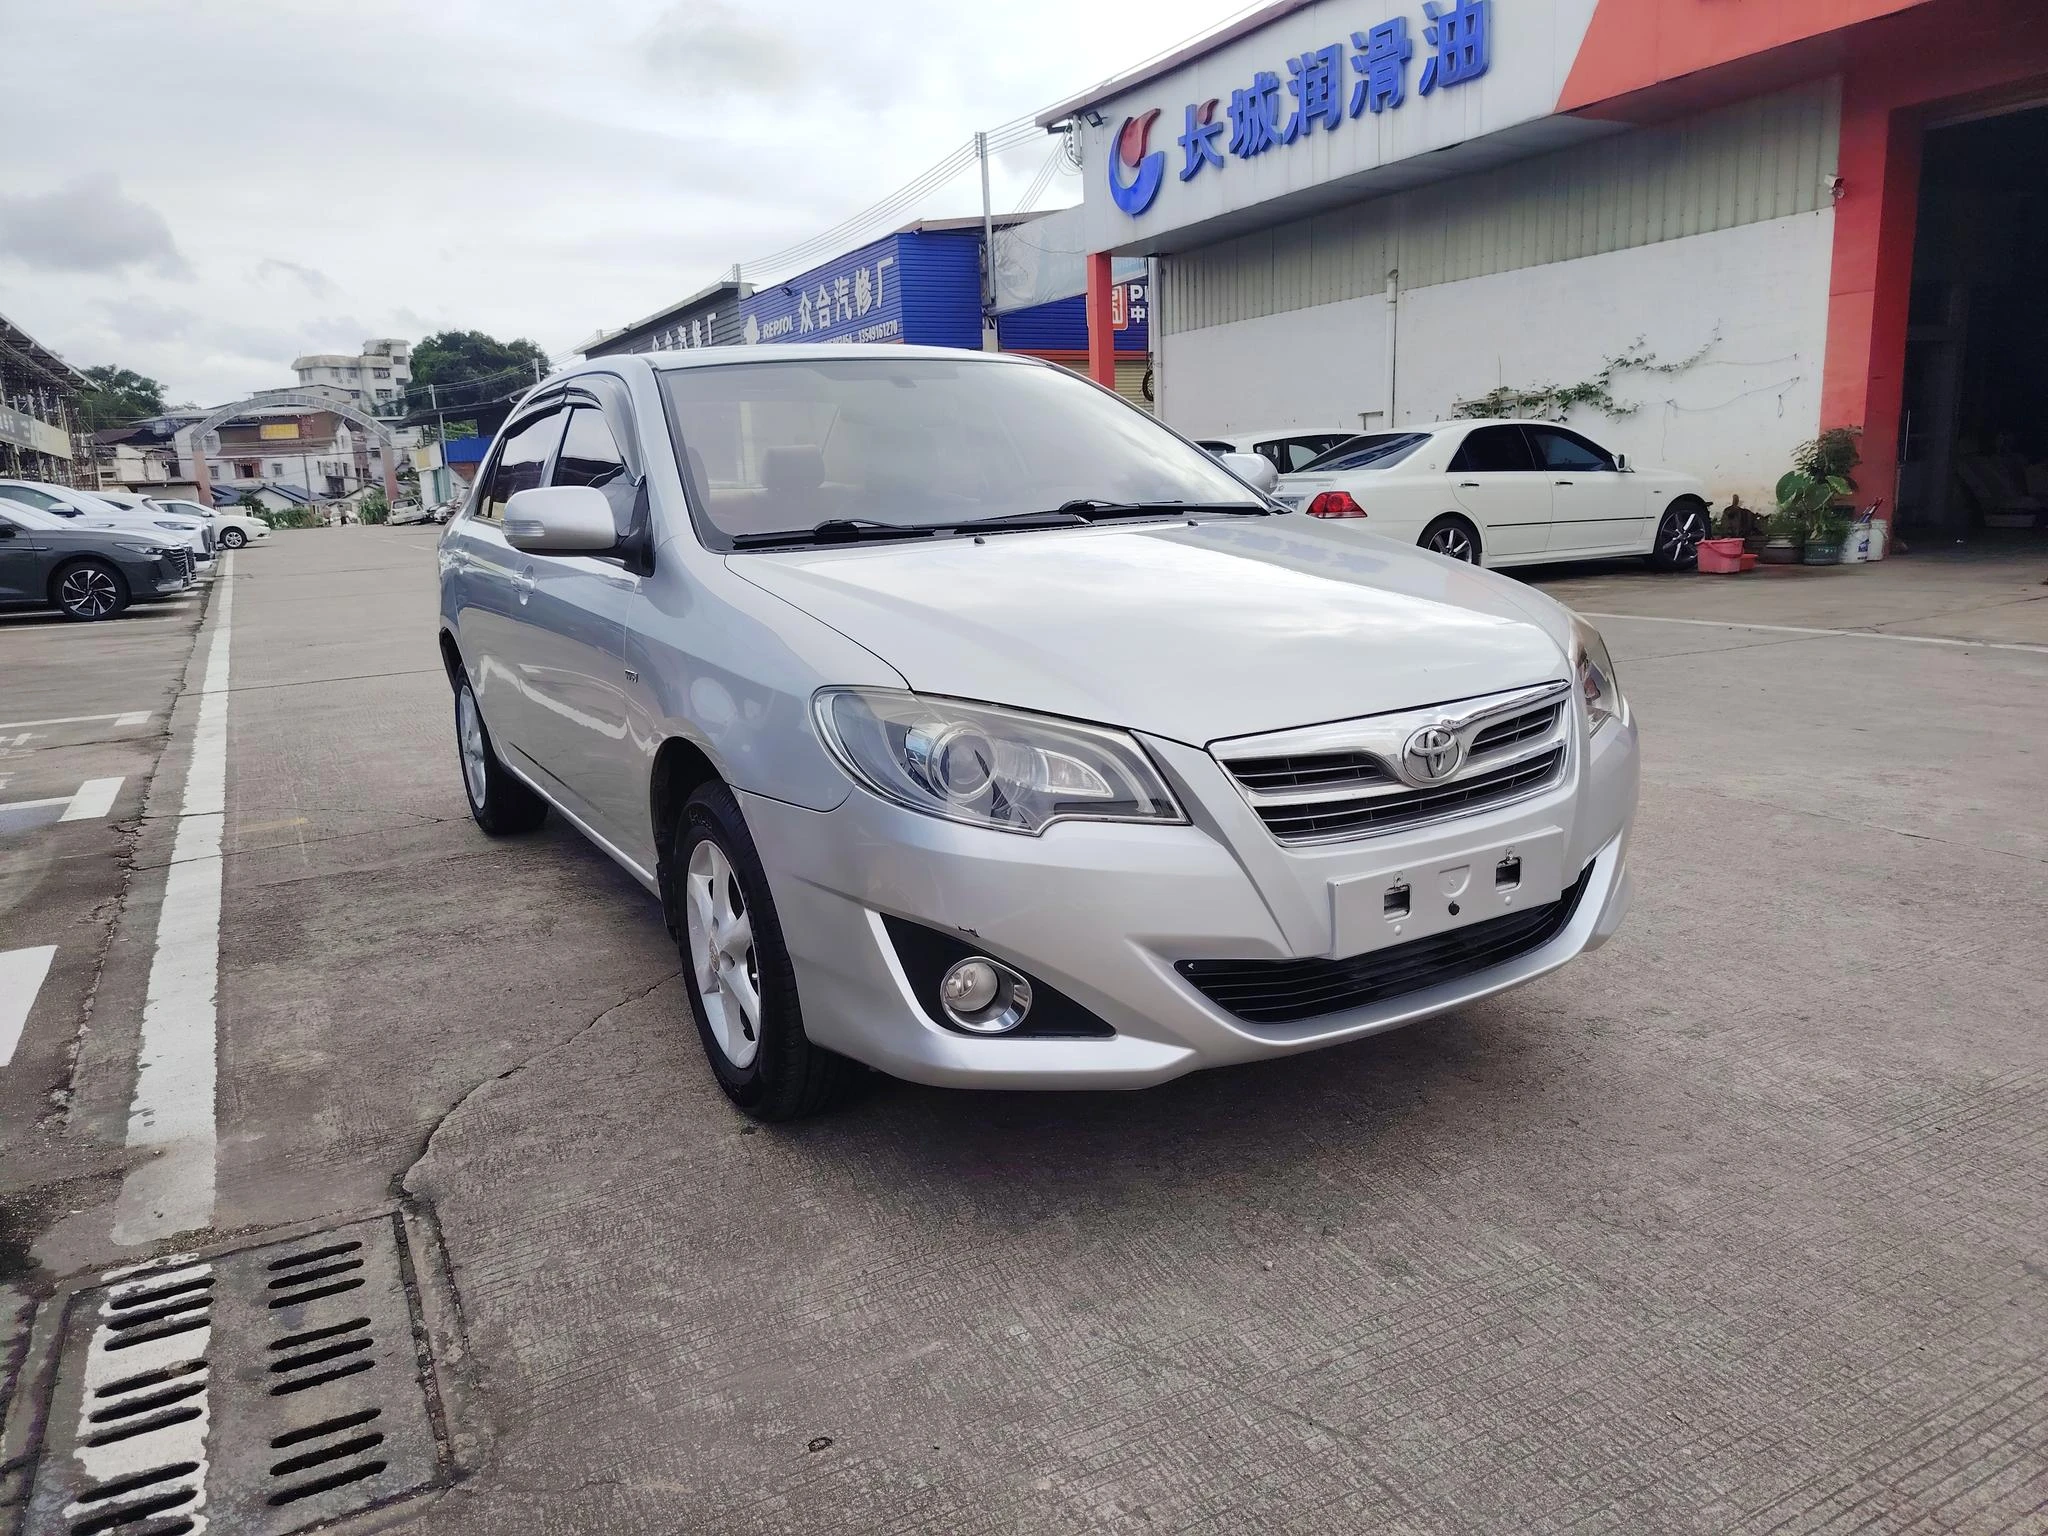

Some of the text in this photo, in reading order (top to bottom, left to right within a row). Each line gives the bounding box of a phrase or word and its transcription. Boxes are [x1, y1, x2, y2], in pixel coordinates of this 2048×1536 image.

[1178, 0, 1491, 182] 长城润滑油
[799, 256, 894, 335] 众合汽修厂
[1130, 284, 1148, 302] P
[763, 315, 794, 340] REPSOL
